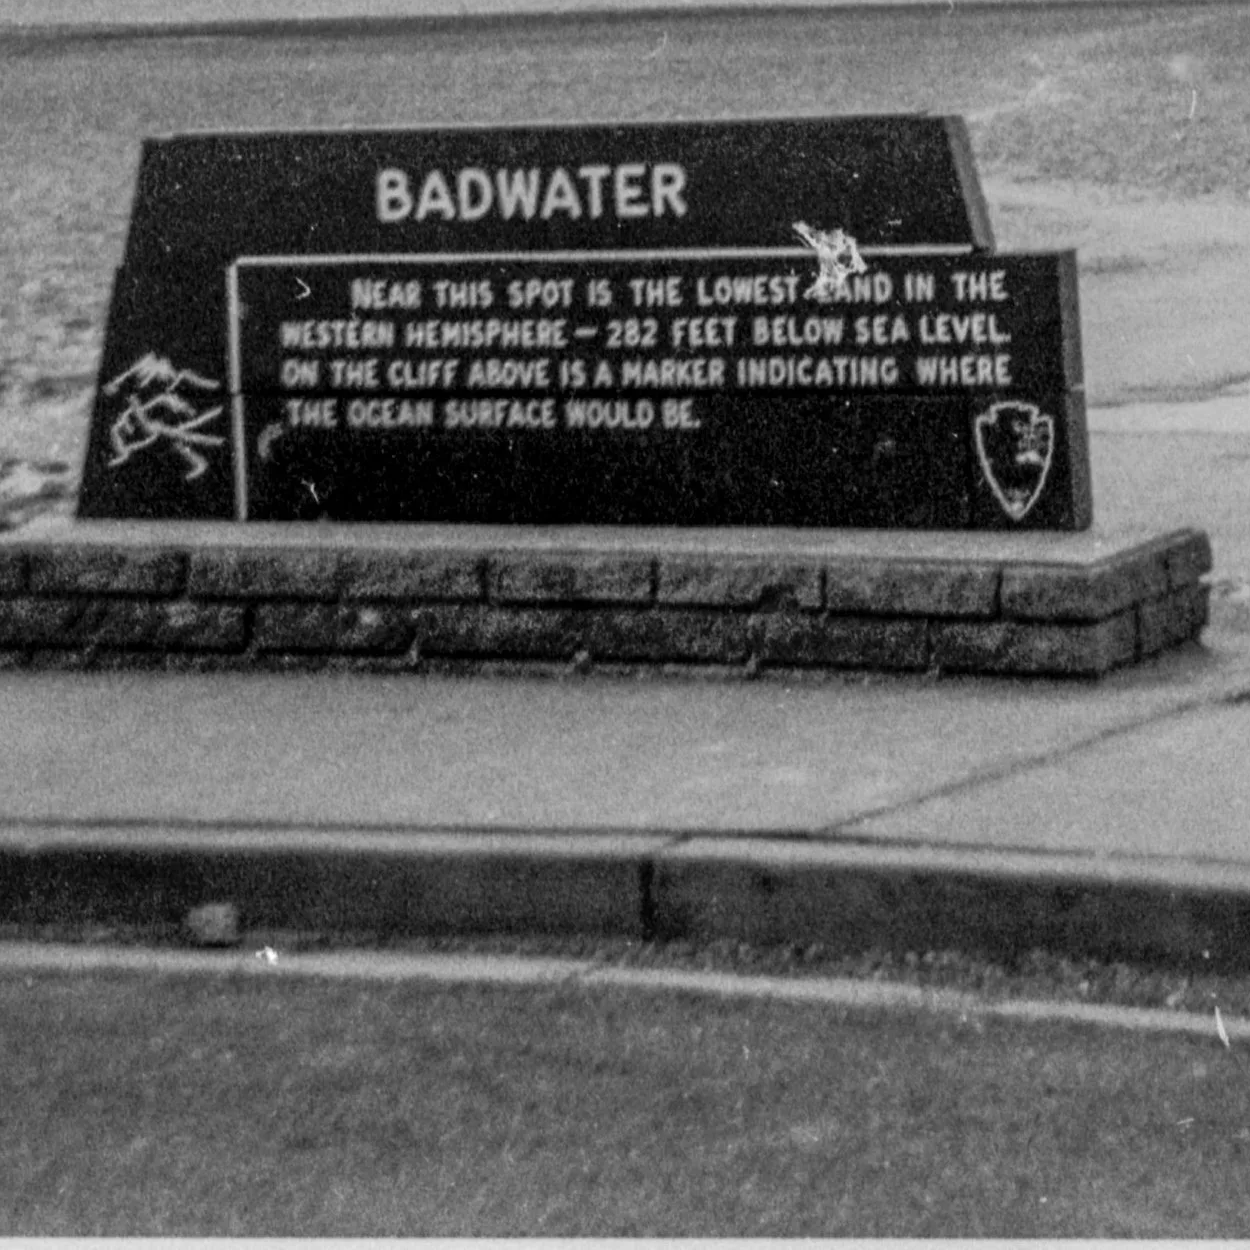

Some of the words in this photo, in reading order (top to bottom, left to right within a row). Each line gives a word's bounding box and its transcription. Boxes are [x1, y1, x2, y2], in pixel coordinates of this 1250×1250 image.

[376, 161, 687, 223] BADWATER
[351, 278, 421, 309] NEAR
[433, 280, 493, 308] THIS
[508, 278, 574, 308] SPOT
[588, 279, 612, 306] IS
[629, 276, 683, 307] THE
[697, 276, 799, 307] LOWEST
[905, 273, 935, 302] IN
[951, 270, 1008, 301] THE
[280, 319, 394, 349] WESTERN
[671, 316, 737, 347] FEET
[754, 316, 844, 346] BELOW
[855, 314, 910, 345] SEA
[919, 312, 1011, 346] LEVEL.
[281, 359, 318, 387] ON
[330, 358, 379, 387] THE
[388, 359, 458, 387] CLIFF
[468, 358, 549, 387] ABOVE
[560, 359, 586, 388] IS
[594, 361, 612, 386] A
[622, 358, 724, 387] MARKER
[738, 356, 898, 386] INDICATING
[916, 353, 1012, 386] WHERE
[286, 399, 337, 427] THE
[347, 399, 433, 428] OCEAN
[445, 399, 556, 428] SURFACE
[565, 400, 654, 429] WOULD
[662, 399, 701, 428] BE.
